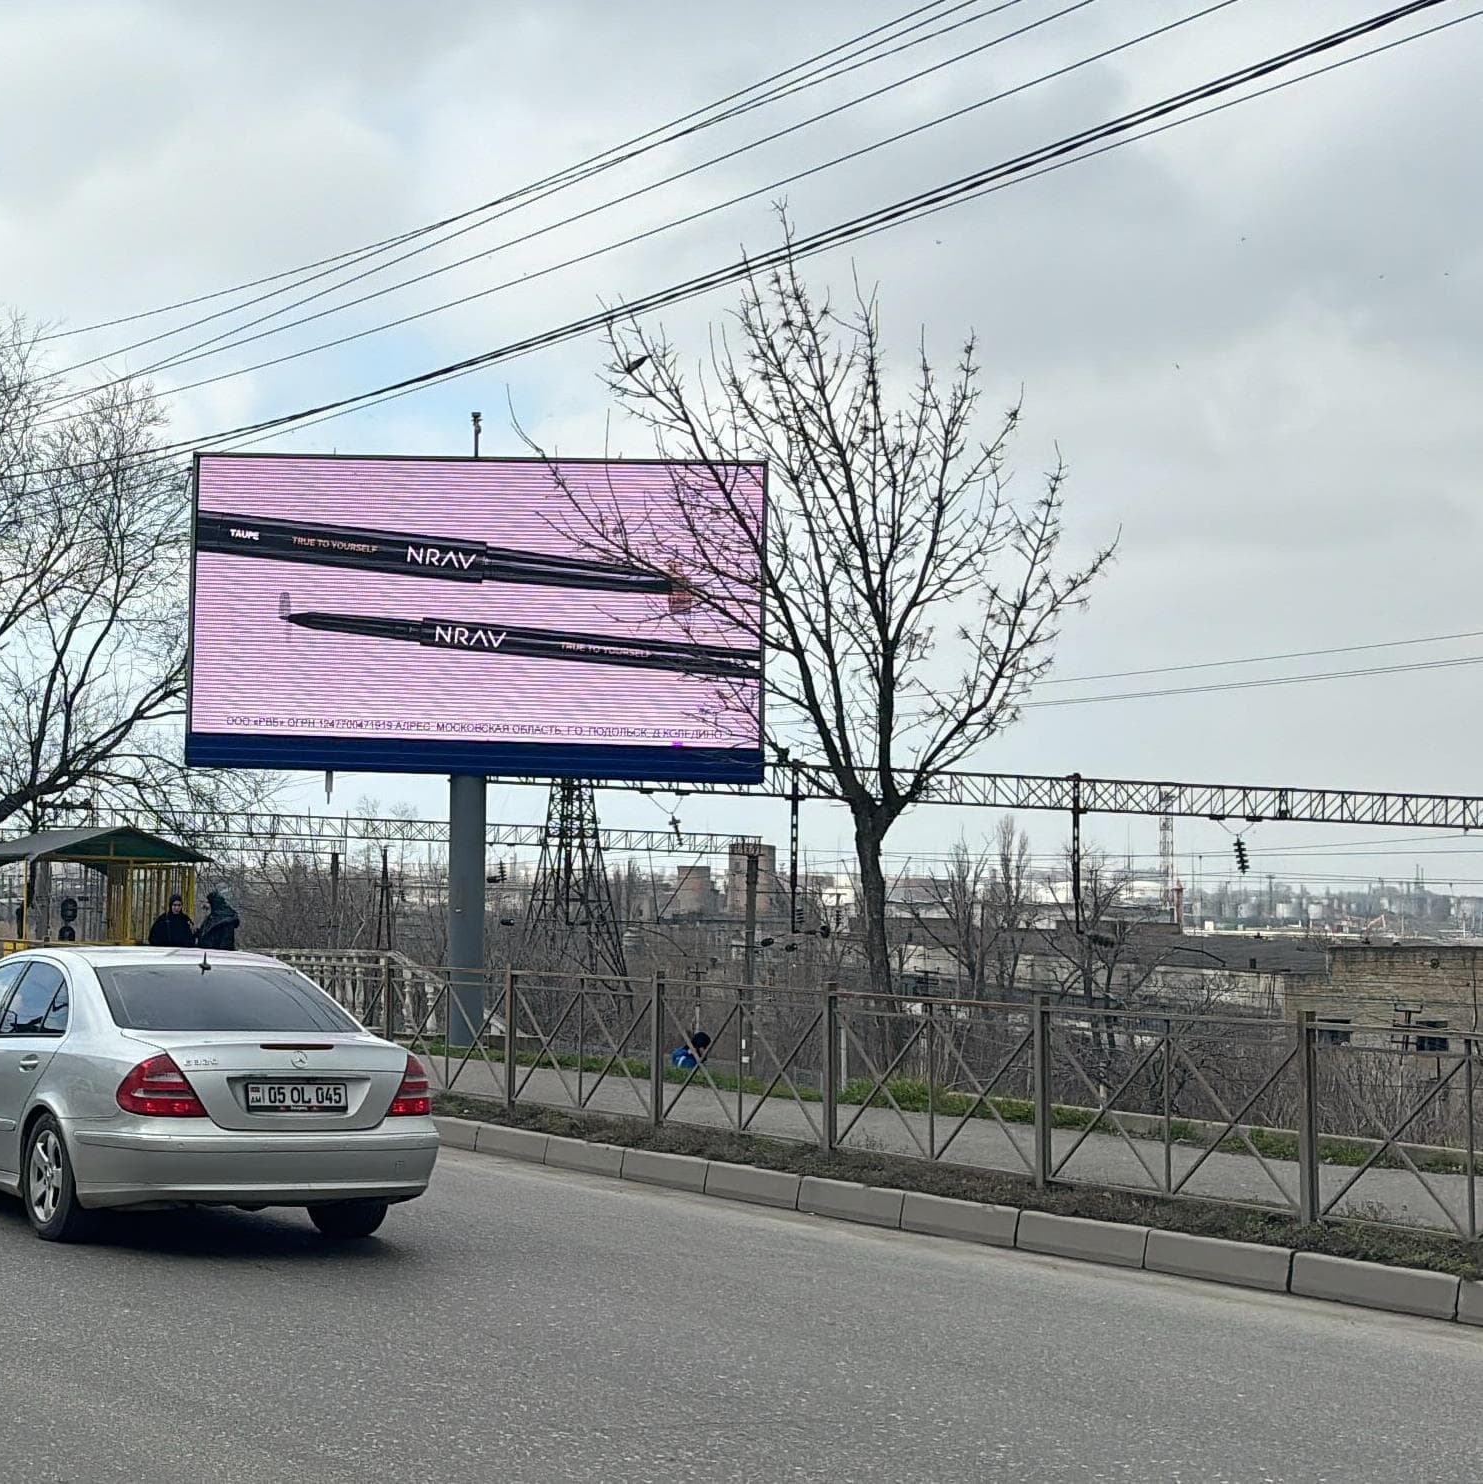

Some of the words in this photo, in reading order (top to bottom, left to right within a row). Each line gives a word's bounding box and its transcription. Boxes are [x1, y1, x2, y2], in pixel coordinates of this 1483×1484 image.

[230, 528, 260, 541] TAUPE
[291, 535, 316, 547] TRUE
[316, 539, 330, 548] TO
[332, 540, 379, 553] YOURSELF
[226, 716, 250, 726] ООО
[287, 718, 315, 728] ОГРН
[436, 722, 509, 734] МОСКОВСКАЯ
[268, 1086, 286, 1104] 05
[290, 1086, 312, 1104] OL
[316, 1086, 342, 1104] 045
